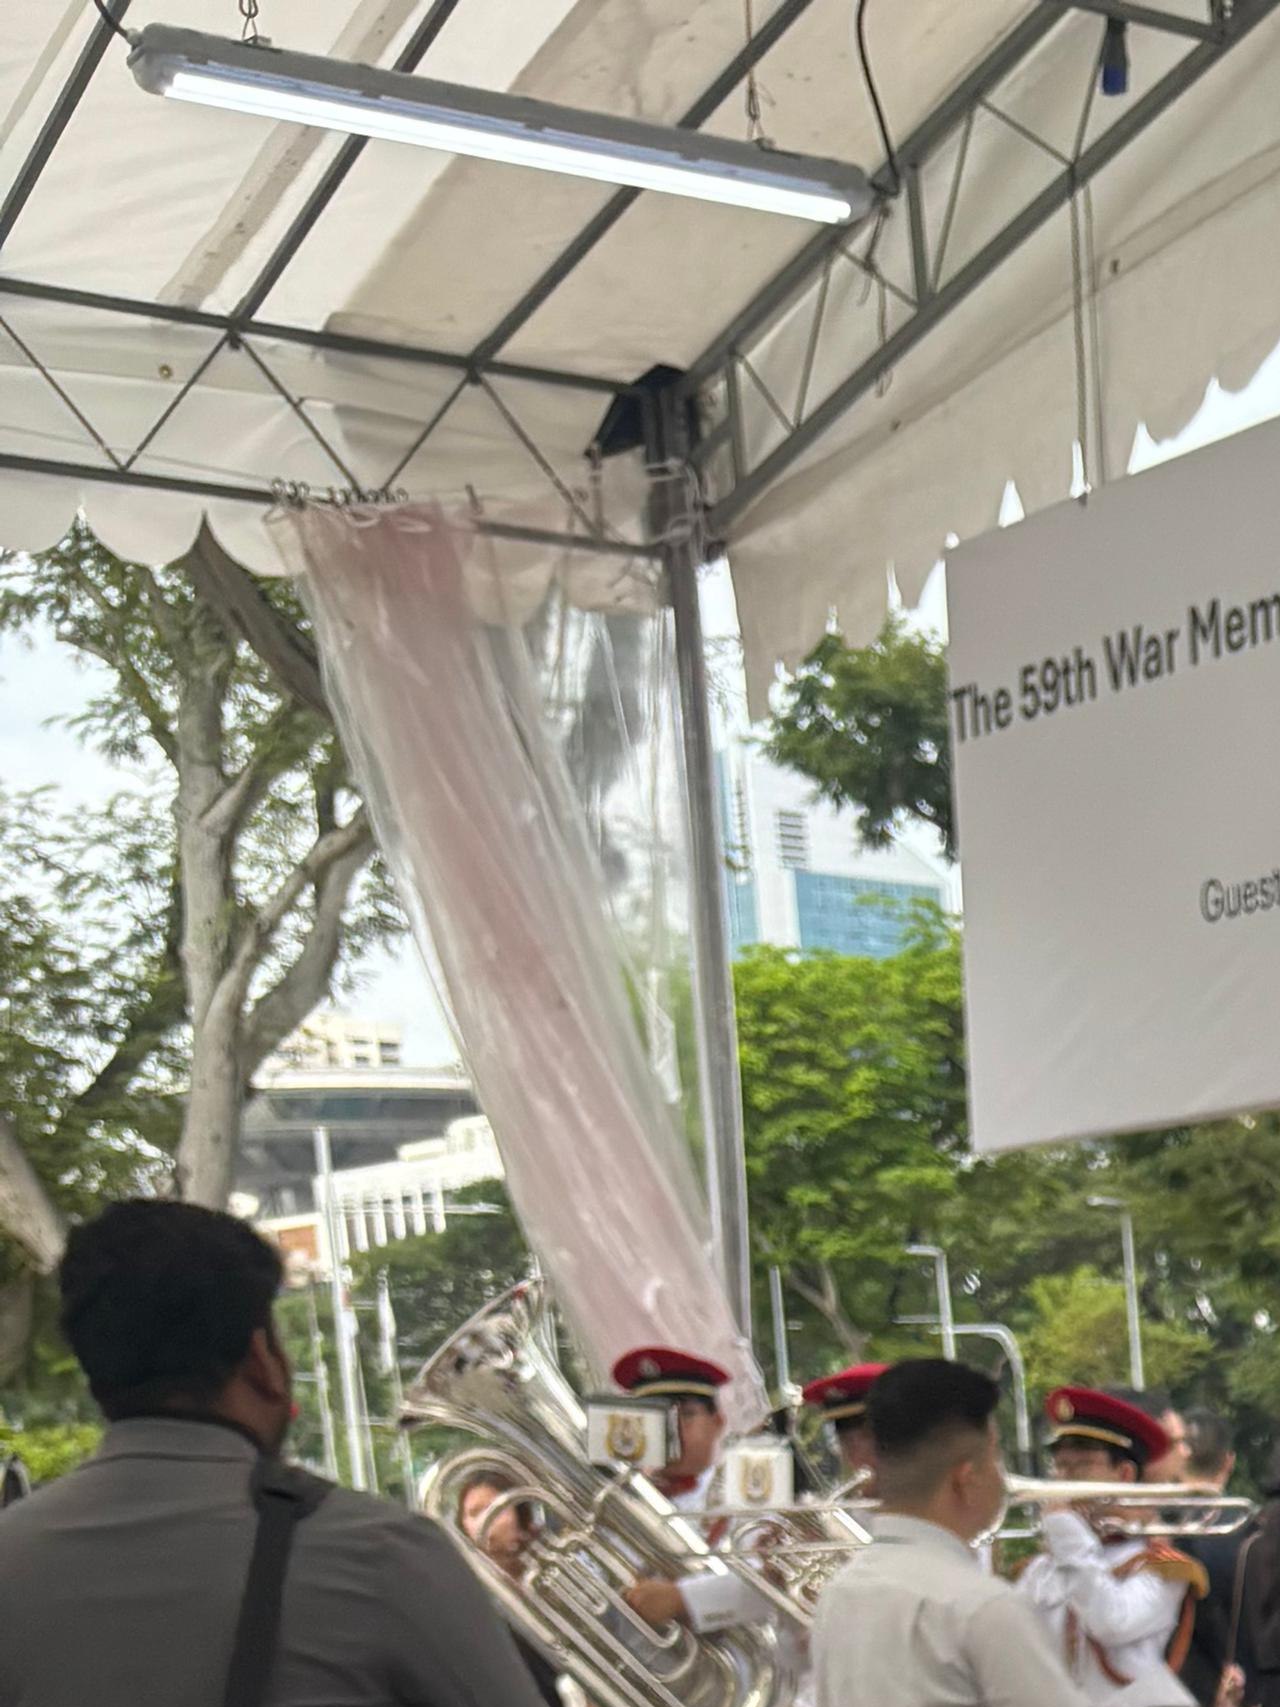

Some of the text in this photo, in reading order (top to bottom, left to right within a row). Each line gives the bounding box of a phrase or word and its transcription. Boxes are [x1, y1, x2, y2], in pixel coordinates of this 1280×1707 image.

[952, 683, 1012, 742] The
[1019, 647, 1097, 720] 59th
[1103, 628, 1180, 692] War
